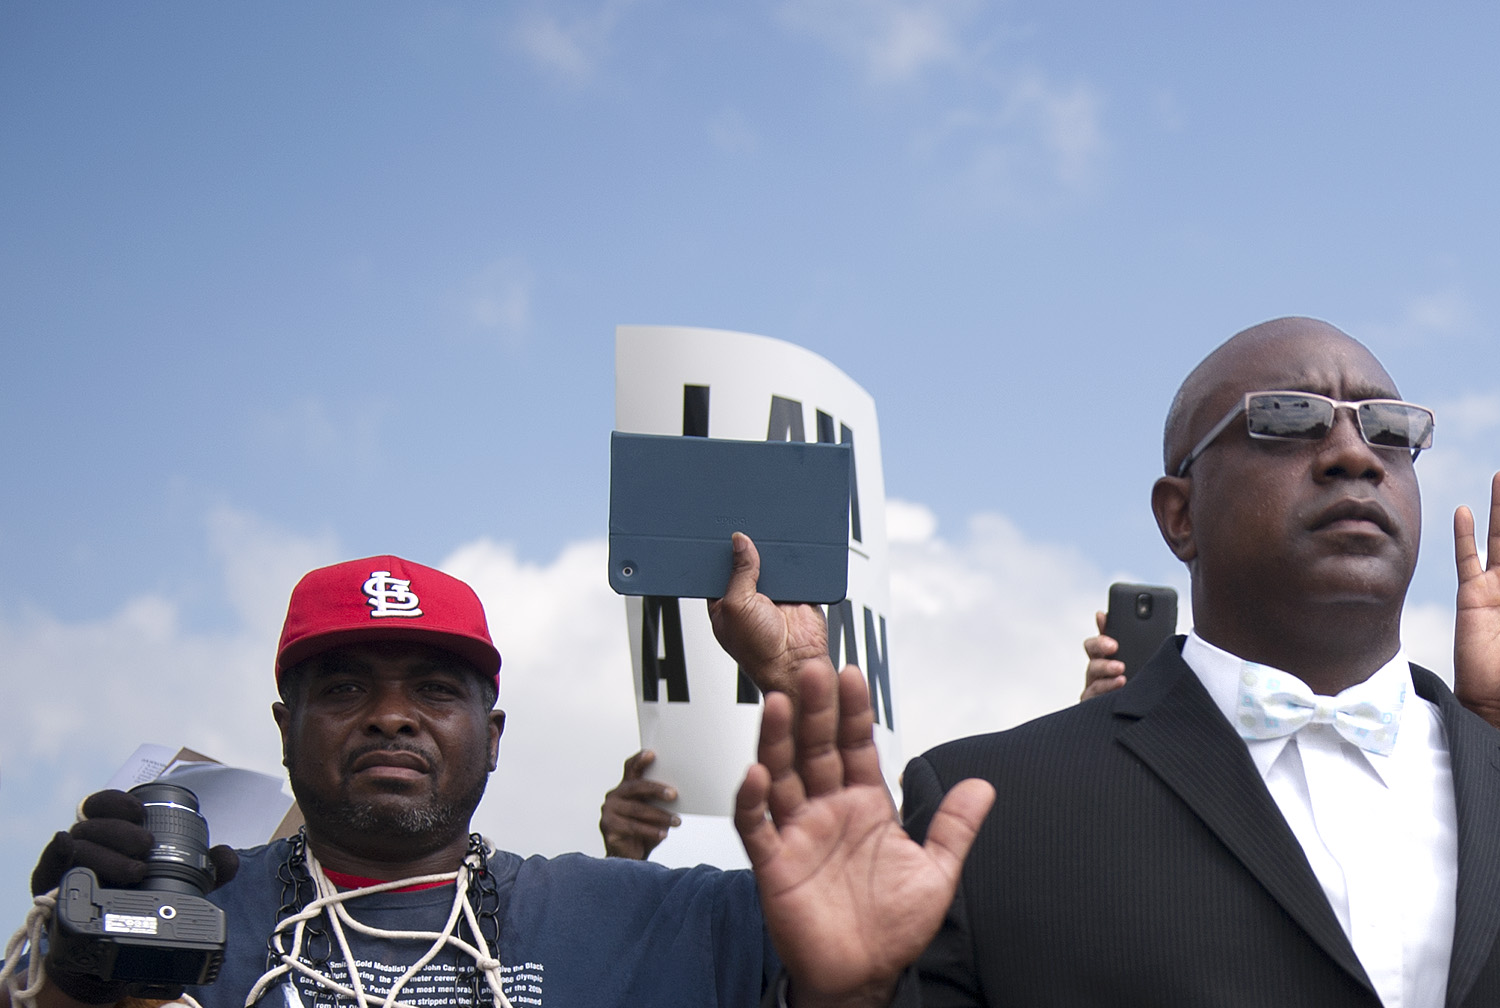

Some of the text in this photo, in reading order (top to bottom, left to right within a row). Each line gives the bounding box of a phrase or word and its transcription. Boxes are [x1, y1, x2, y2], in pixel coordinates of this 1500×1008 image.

[643, 596, 894, 732] A AN
[525, 962, 544, 971] Black
[359, 971, 374, 981] ring
[379, 975, 391, 984] the
[516, 973, 543, 983] Olympic
[417, 998, 447, 1006] stripped
